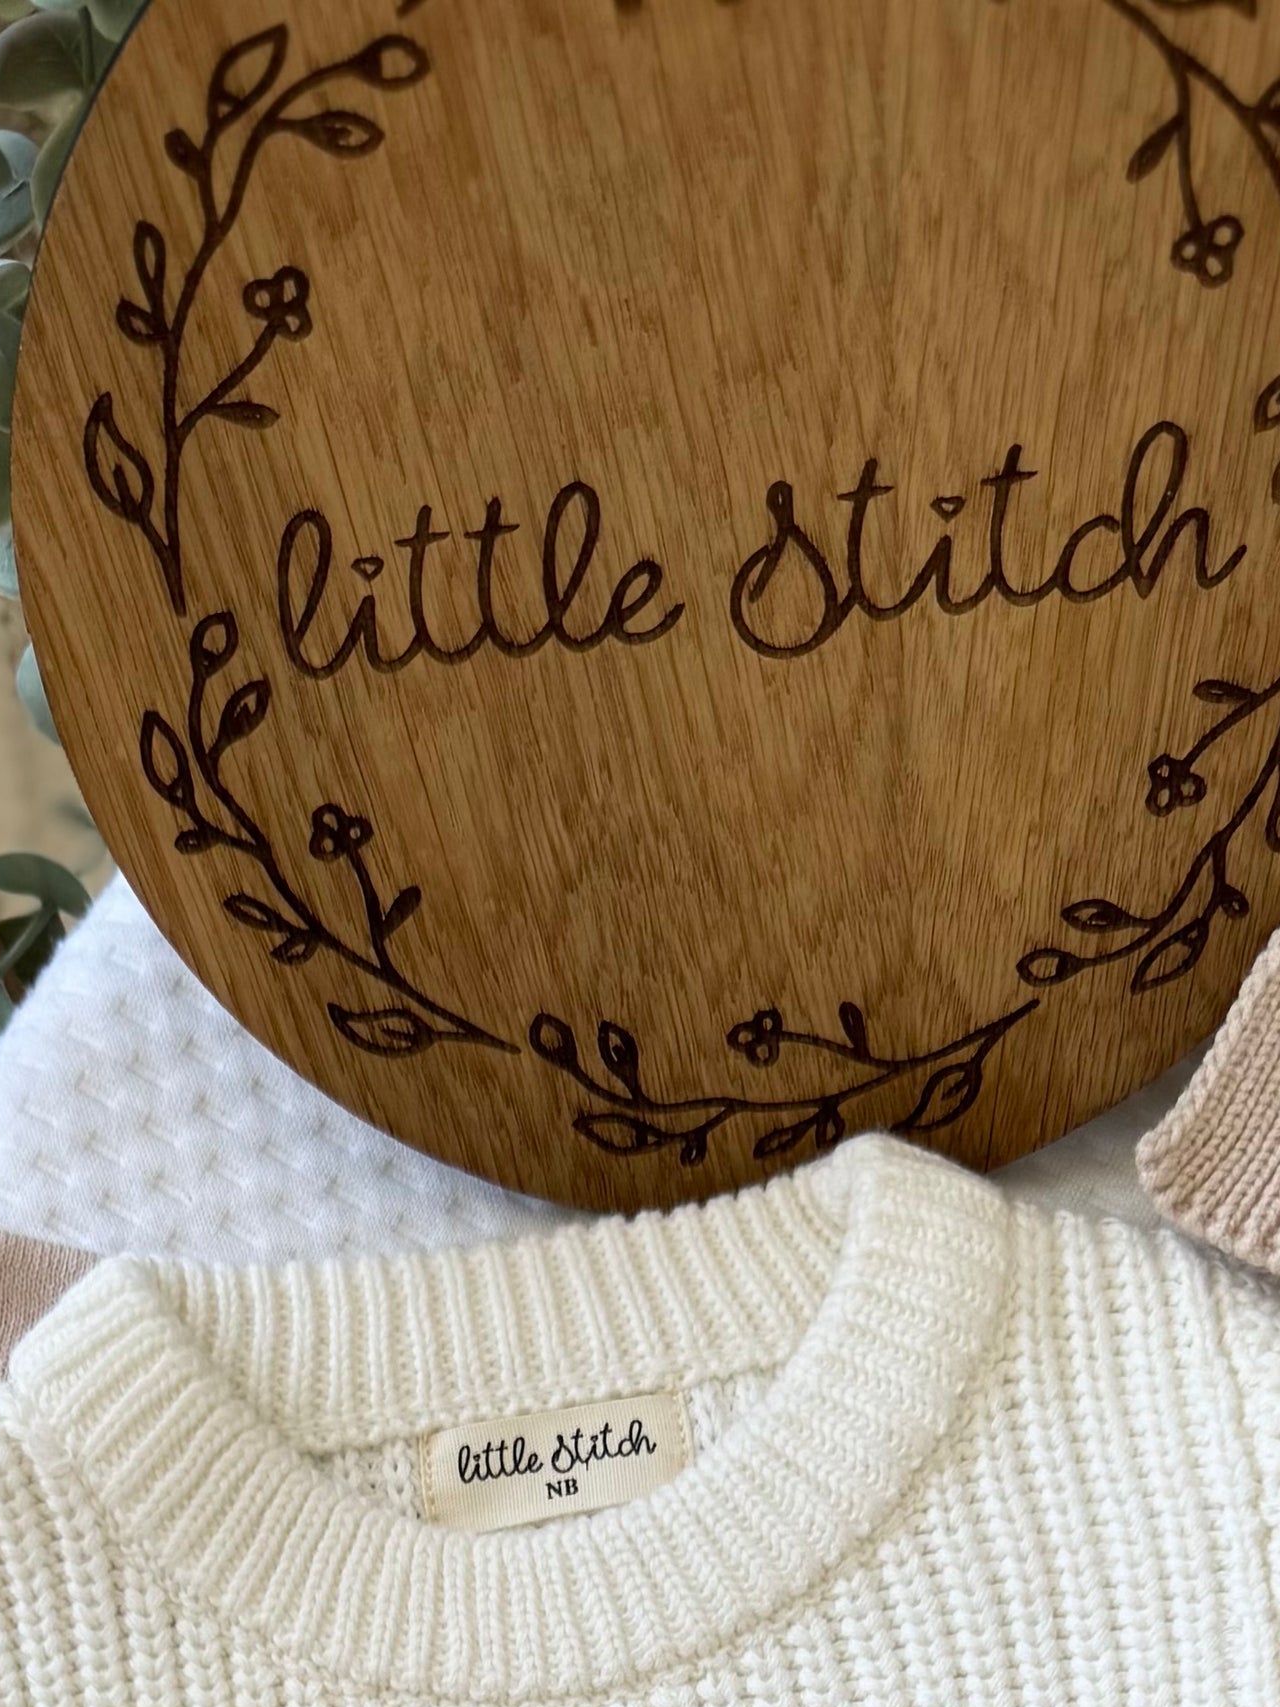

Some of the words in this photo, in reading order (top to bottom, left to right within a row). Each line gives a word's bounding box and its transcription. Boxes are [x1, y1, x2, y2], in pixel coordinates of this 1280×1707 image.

[276, 480, 686, 681] little
[458, 1436, 544, 1484] little
[545, 1477, 580, 1501] NB
